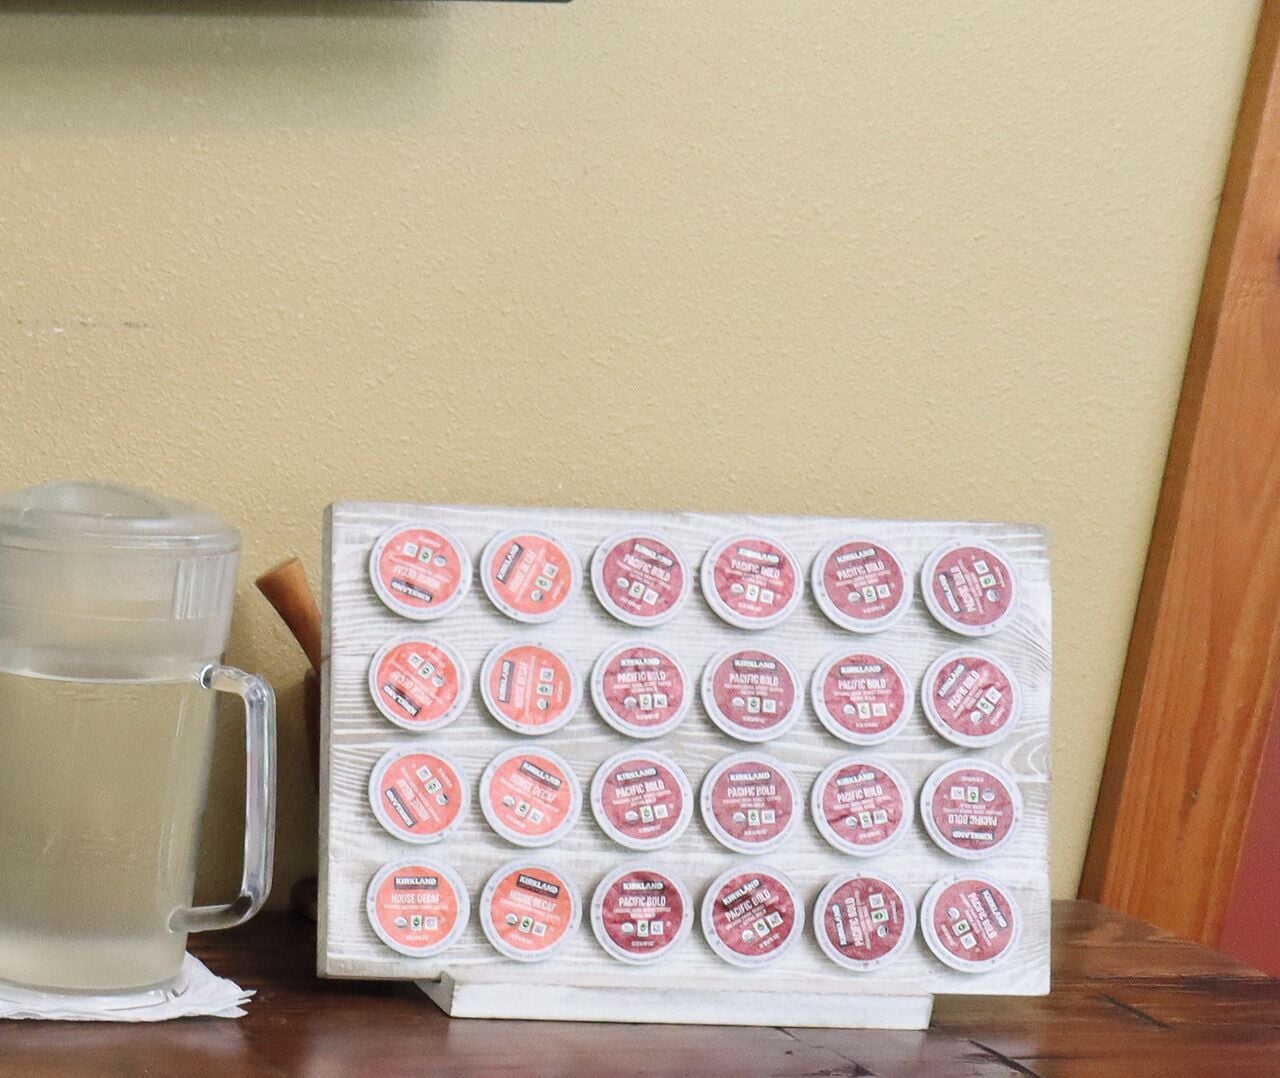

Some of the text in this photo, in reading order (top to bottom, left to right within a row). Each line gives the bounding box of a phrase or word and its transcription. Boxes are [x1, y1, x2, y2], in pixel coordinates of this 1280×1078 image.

[620, 657, 660, 665] KIRKLAND
[733, 659, 775, 669] KIRKLAND
[617, 671, 665, 682] PACIFIC BOLD
[729, 673, 779, 686] PACIFIC BOLD
[838, 678, 886, 689] PACIFIC BOLD
[616, 768, 657, 780] KIRKLAND
[729, 772, 770, 781] KIRKLAND
[836, 772, 875, 786] KIRKLAND
[615, 780, 665, 797] PACIFIC BOLD
[727, 785, 776, 797] PACIFIC BOLD
[836, 785, 883, 803] PACIFIC BOLD
[947, 813, 997, 826] PACIFIC BOLD
[952, 830, 993, 840] KIRKLAND
[395, 877, 436, 886] KIRKLAND
[518, 874, 559, 894] KIRKLAND
[622, 881, 663, 891] KIRKLAND
[391, 892, 439, 904] HOUSE DECAF
[719, 878, 761, 906] KIRKLAND
[507, 887, 557, 912] HOUSE DECAF
[618, 896, 666, 906] PACIFIC BOLD
[722, 888, 772, 921] PACIFIC BOLD
[981, 888, 1007, 929] KIRKLAND
[844, 896, 864, 947] PACIFIC BOLD
[967, 891, 997, 941] PACIFIC BOLD
[831, 903, 848, 946] KIRKLAND
